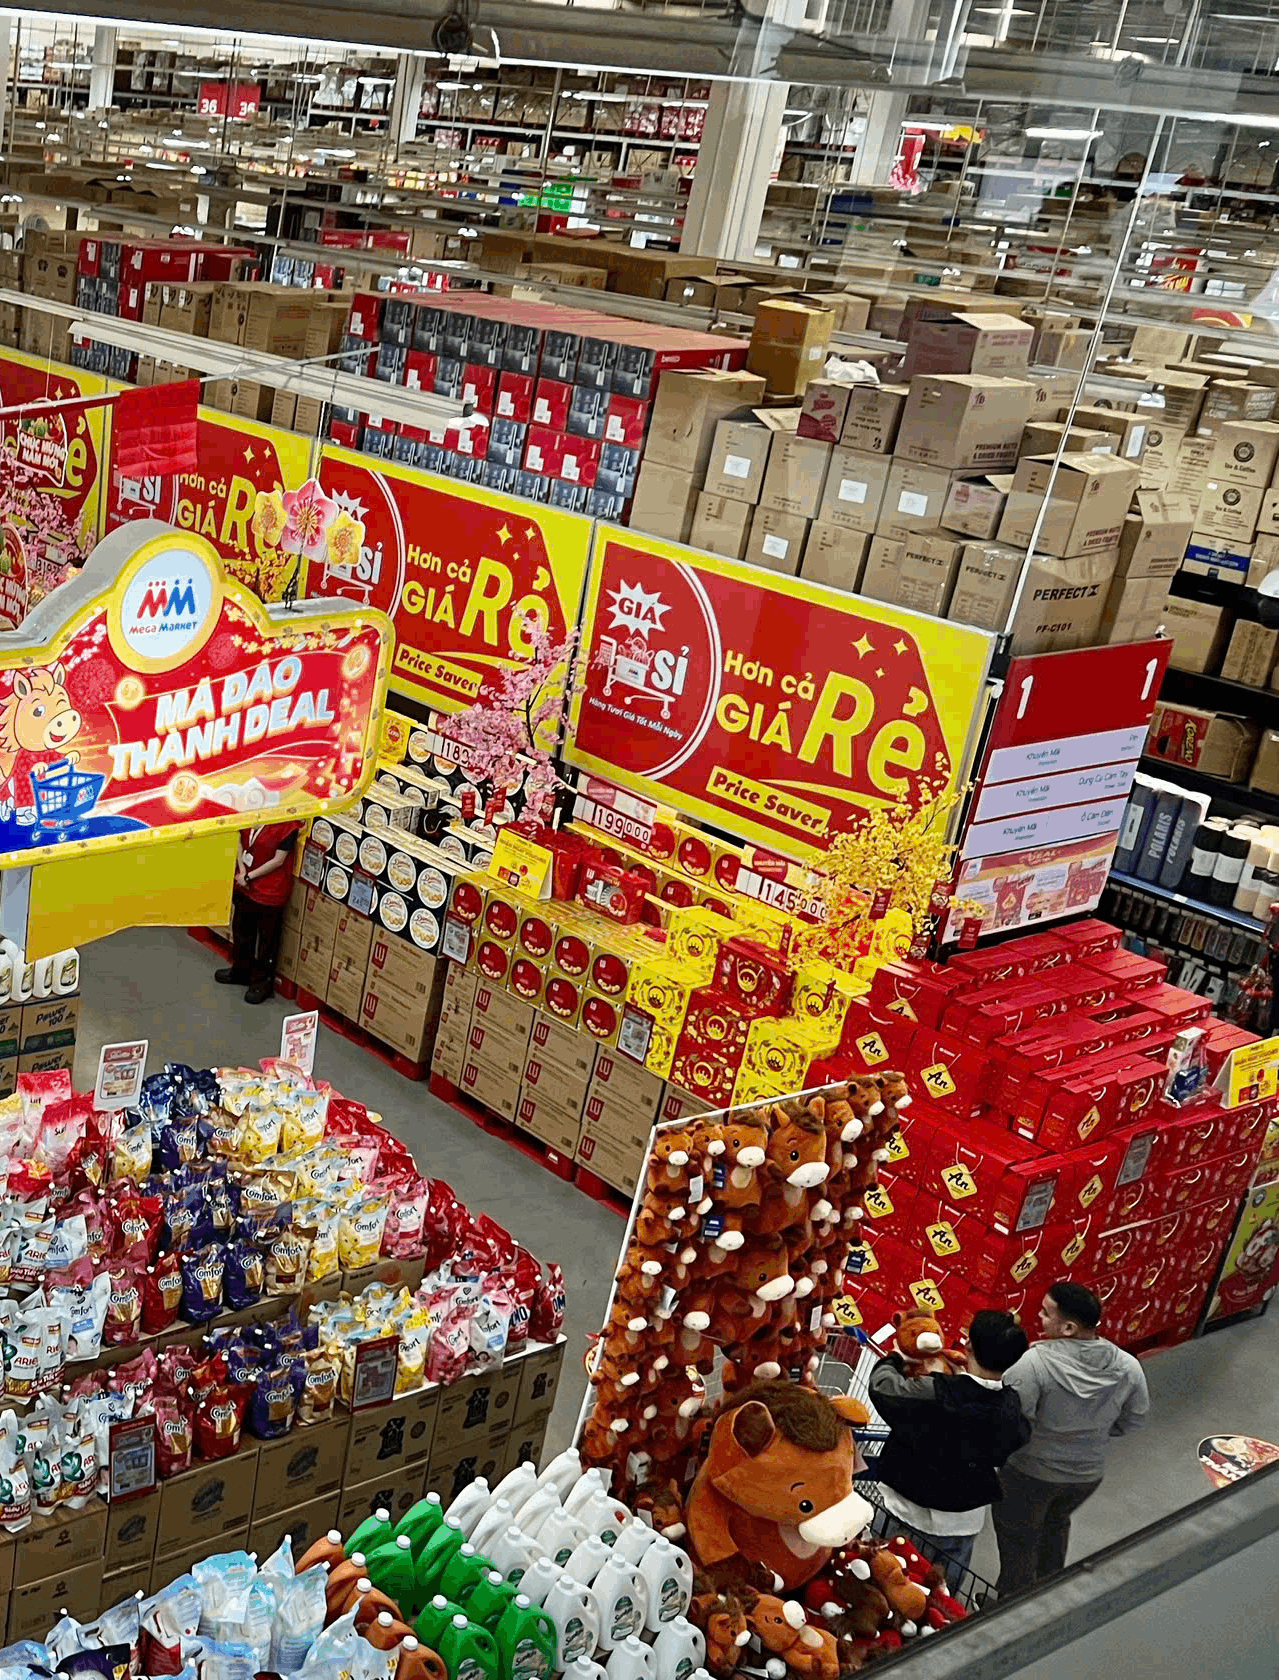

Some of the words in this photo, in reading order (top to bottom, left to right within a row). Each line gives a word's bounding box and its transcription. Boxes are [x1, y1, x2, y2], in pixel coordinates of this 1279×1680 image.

[200, 98, 218, 114] 36
[239, 101, 256, 117] 36
[176, 498, 218, 539] GIÁ
[406, 543, 443, 569] Hơn
[446, 558, 472, 583] cả
[402, 577, 454, 630] GIÁ
[458, 556, 551, 660] Rẻ
[618, 595, 660, 626] GIÁ
[1034, 586, 1087, 601] PERFECT
[397, 648, 430, 677] Price
[431, 660, 477, 693] Saver
[652, 645, 691, 695] SỈ
[724, 649, 774, 686] Hơn
[780, 671, 816, 701] cả
[1140, 657, 1158, 701] 1
[1016, 675, 1034, 720] 1
[243, 687, 336, 749] DEAL
[715, 692, 792, 754] GIÁ
[797, 670, 930, 796] Rẻ
[712, 771, 761, 807] Price
[763, 785, 824, 833] Saver
[597, 808, 623, 835] 199
[625, 818, 649, 842] 000
[1147, 811, 1173, 860] POLARIS
[48, 1014, 64, 1027] 100
[863, 1039, 882, 1058] An
[927, 1071, 948, 1089] An
[949, 1174, 970, 1191] An
[932, 1231, 954, 1247] An
[159, 1275, 182, 1290] Comfo
[916, 1287, 937, 1304] An
[837, 1300, 858, 1318] An
[14, 1357, 39, 1366] ARIE
